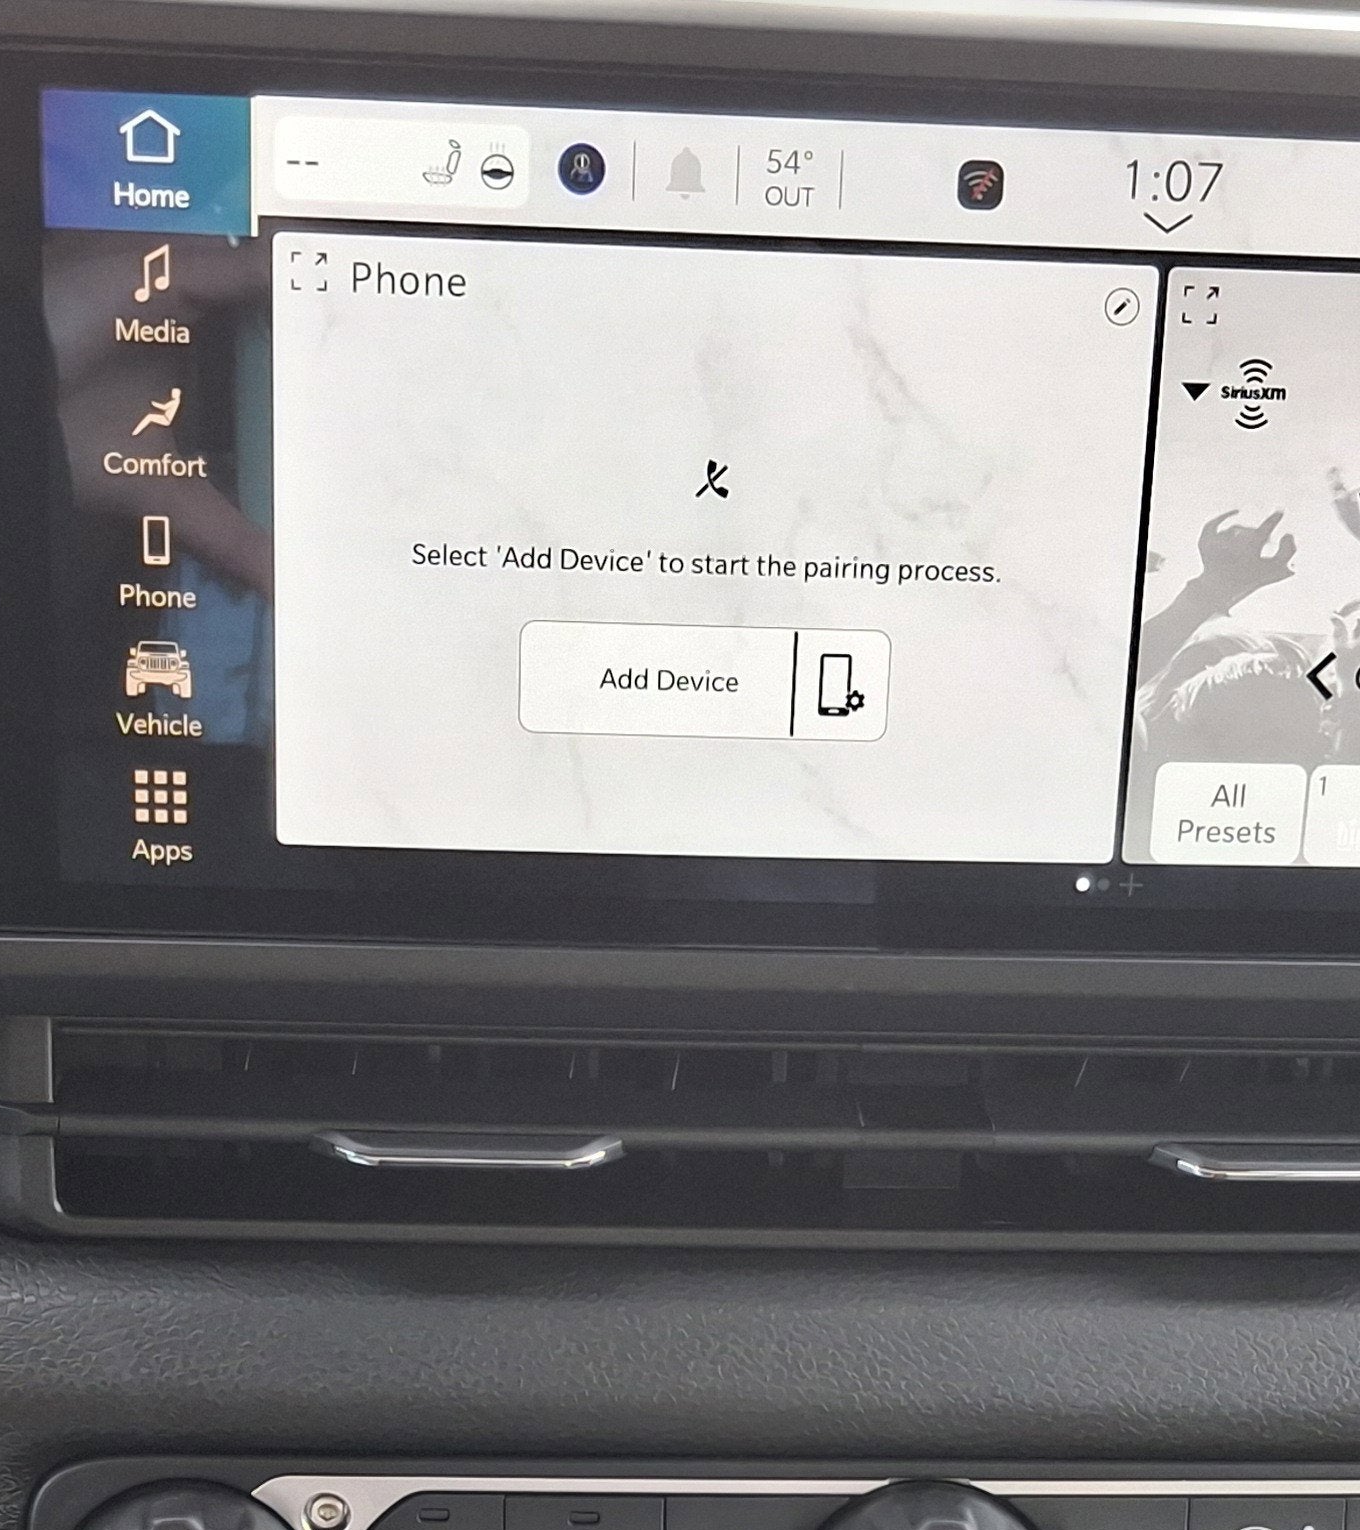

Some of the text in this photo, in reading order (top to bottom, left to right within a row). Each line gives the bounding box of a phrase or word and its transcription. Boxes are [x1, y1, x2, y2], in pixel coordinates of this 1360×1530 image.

[765, 148, 814, 176] 54°
[1126, 159, 1224, 203] 1:07
[113, 181, 190, 209] Home
[765, 186, 815, 208] OUT
[351, 261, 468, 297] Phone
[115, 318, 191, 344] Media
[103, 451, 208, 479] Comfort
[412, 543, 1002, 586] Select 'Add Device' to start the pairing process.
[119, 583, 197, 609] Phone
[599, 667, 739, 693] Add Device
[116, 713, 203, 738] Vehicle
[1211, 784, 1247, 809] All
[1319, 776, 1328, 796] 1
[1177, 818, 1276, 846] Presets
[131, 839, 193, 865] Apps
